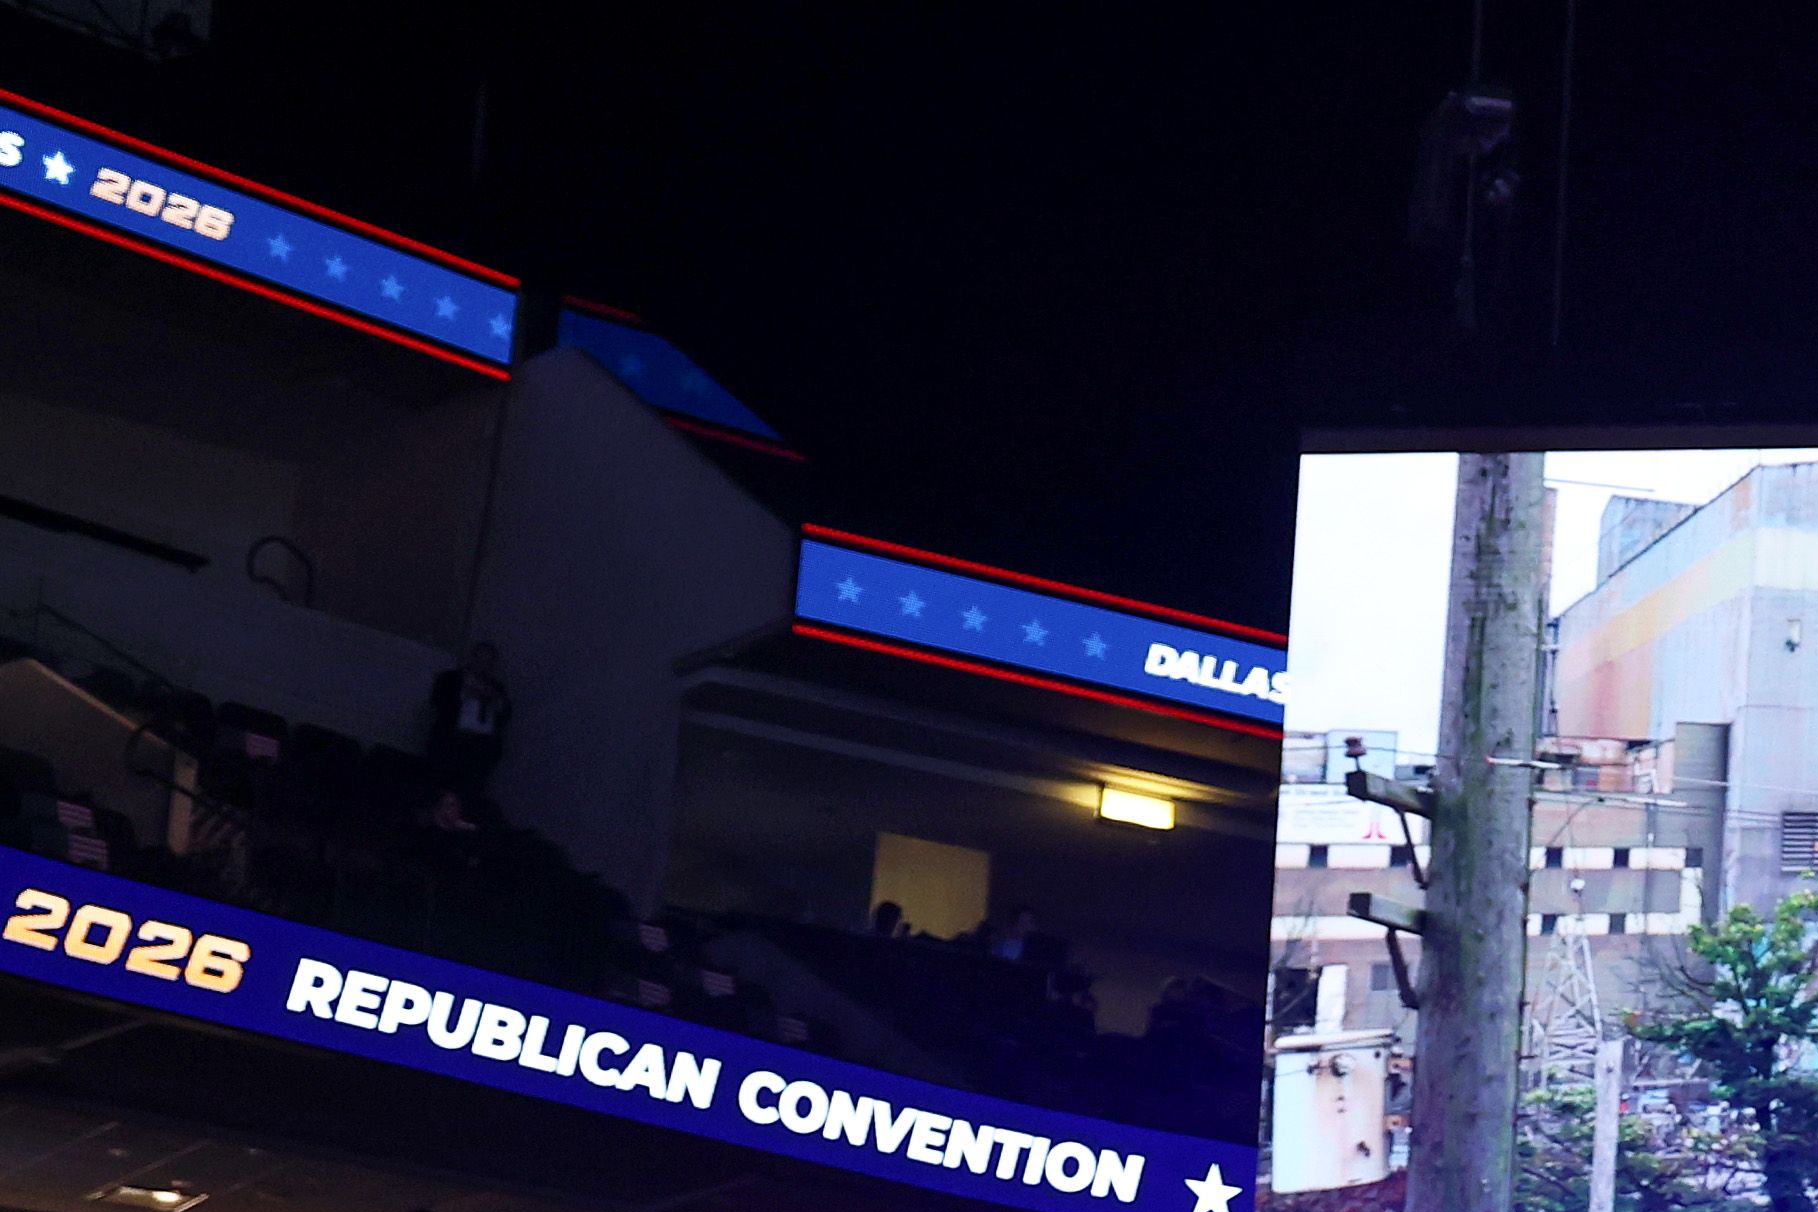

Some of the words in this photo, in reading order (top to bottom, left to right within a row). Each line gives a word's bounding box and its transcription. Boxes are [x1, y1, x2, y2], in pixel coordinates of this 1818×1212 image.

[89, 166, 235, 242] 2026
[1144, 642, 1290, 704] DALLAS
[2, 887, 251, 994] 2026
[287, 958, 722, 1109] REPUBLICAN
[738, 1070, 1146, 1204] CONVENTION
